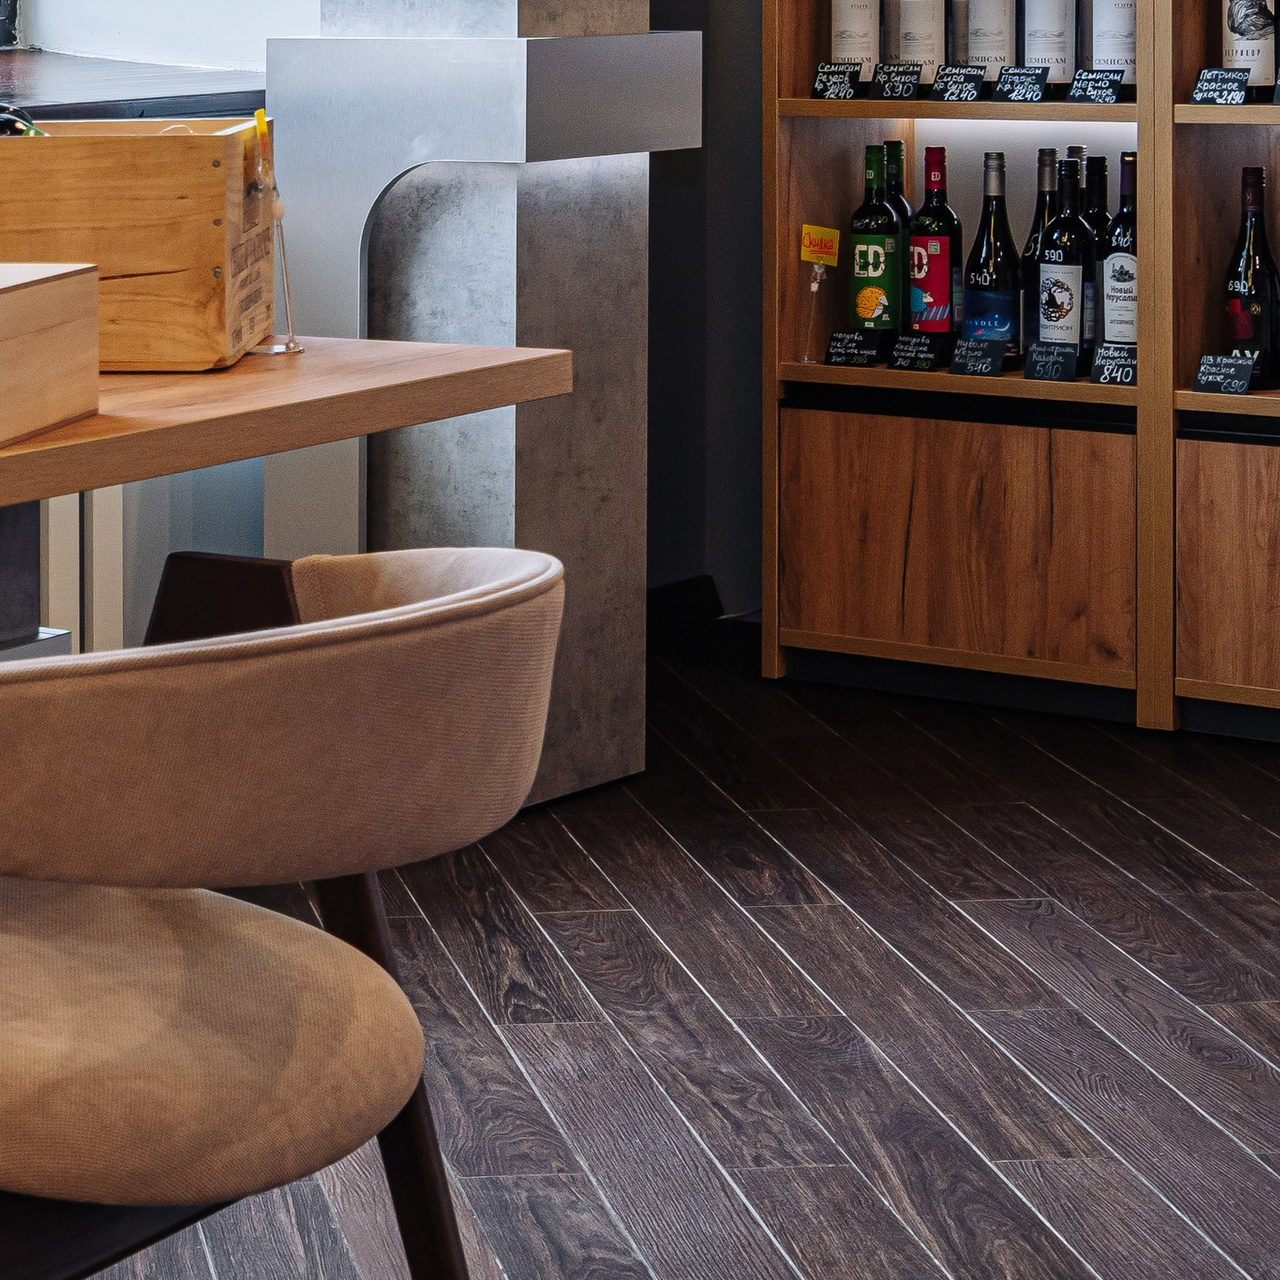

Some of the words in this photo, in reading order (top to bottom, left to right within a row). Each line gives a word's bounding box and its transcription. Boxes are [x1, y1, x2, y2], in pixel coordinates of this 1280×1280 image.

[822, 89, 854, 100] 1240
[943, 89, 977, 101] 1240
[1007, 89, 1042, 101] 1240
[1216, 91, 1245, 105] 2190
[854, 244, 886, 278] ED
[1044, 249, 1064, 262] 590
[1111, 285, 1134, 295] Новый
[1228, 280, 1249, 292] 690
[1095, 356, 1137, 367] Иерусали
[1035, 362, 1062, 379] 590
[1100, 365, 1133, 383] 840
[1221, 379, 1248, 392] 690
